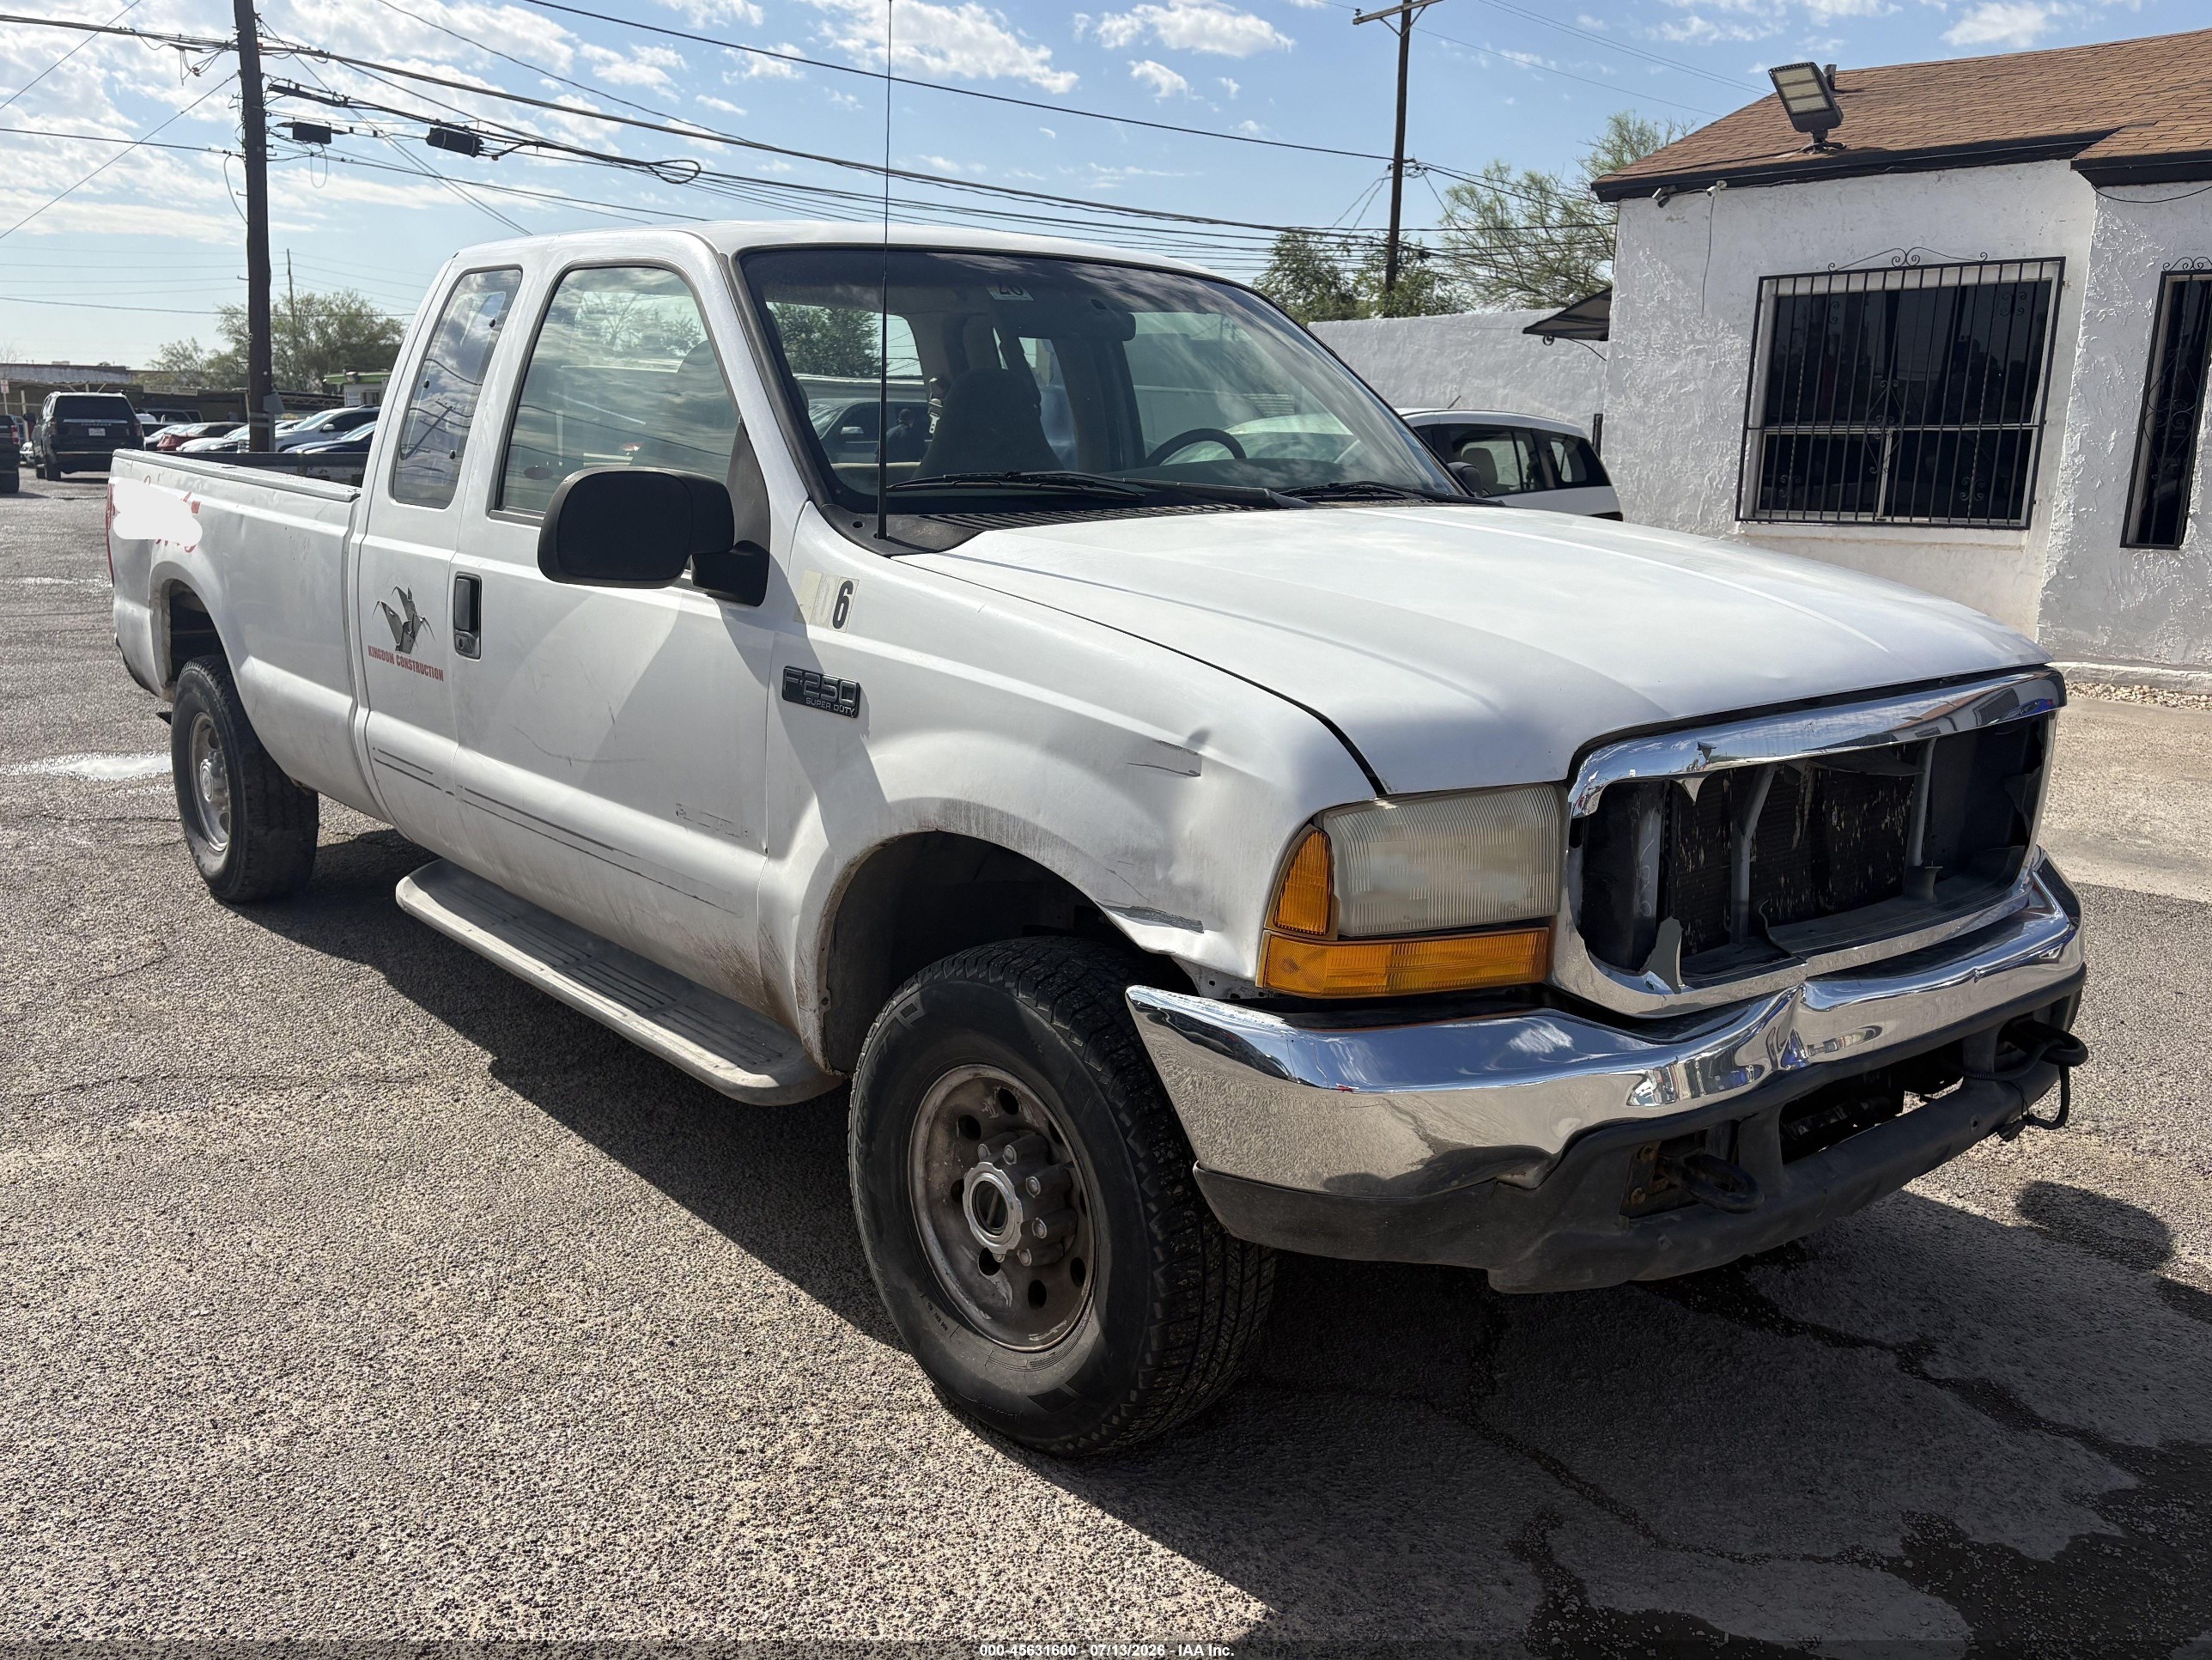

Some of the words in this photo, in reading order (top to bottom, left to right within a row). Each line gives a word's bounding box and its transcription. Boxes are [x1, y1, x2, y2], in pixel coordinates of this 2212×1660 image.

[832, 580, 854, 629] 6
[368, 645, 395, 665] KINGDOM
[396, 654, 444, 682] CONSTRUCTION
[805, 697, 831, 710] SUPER
[833, 705, 855, 718] DUTY
